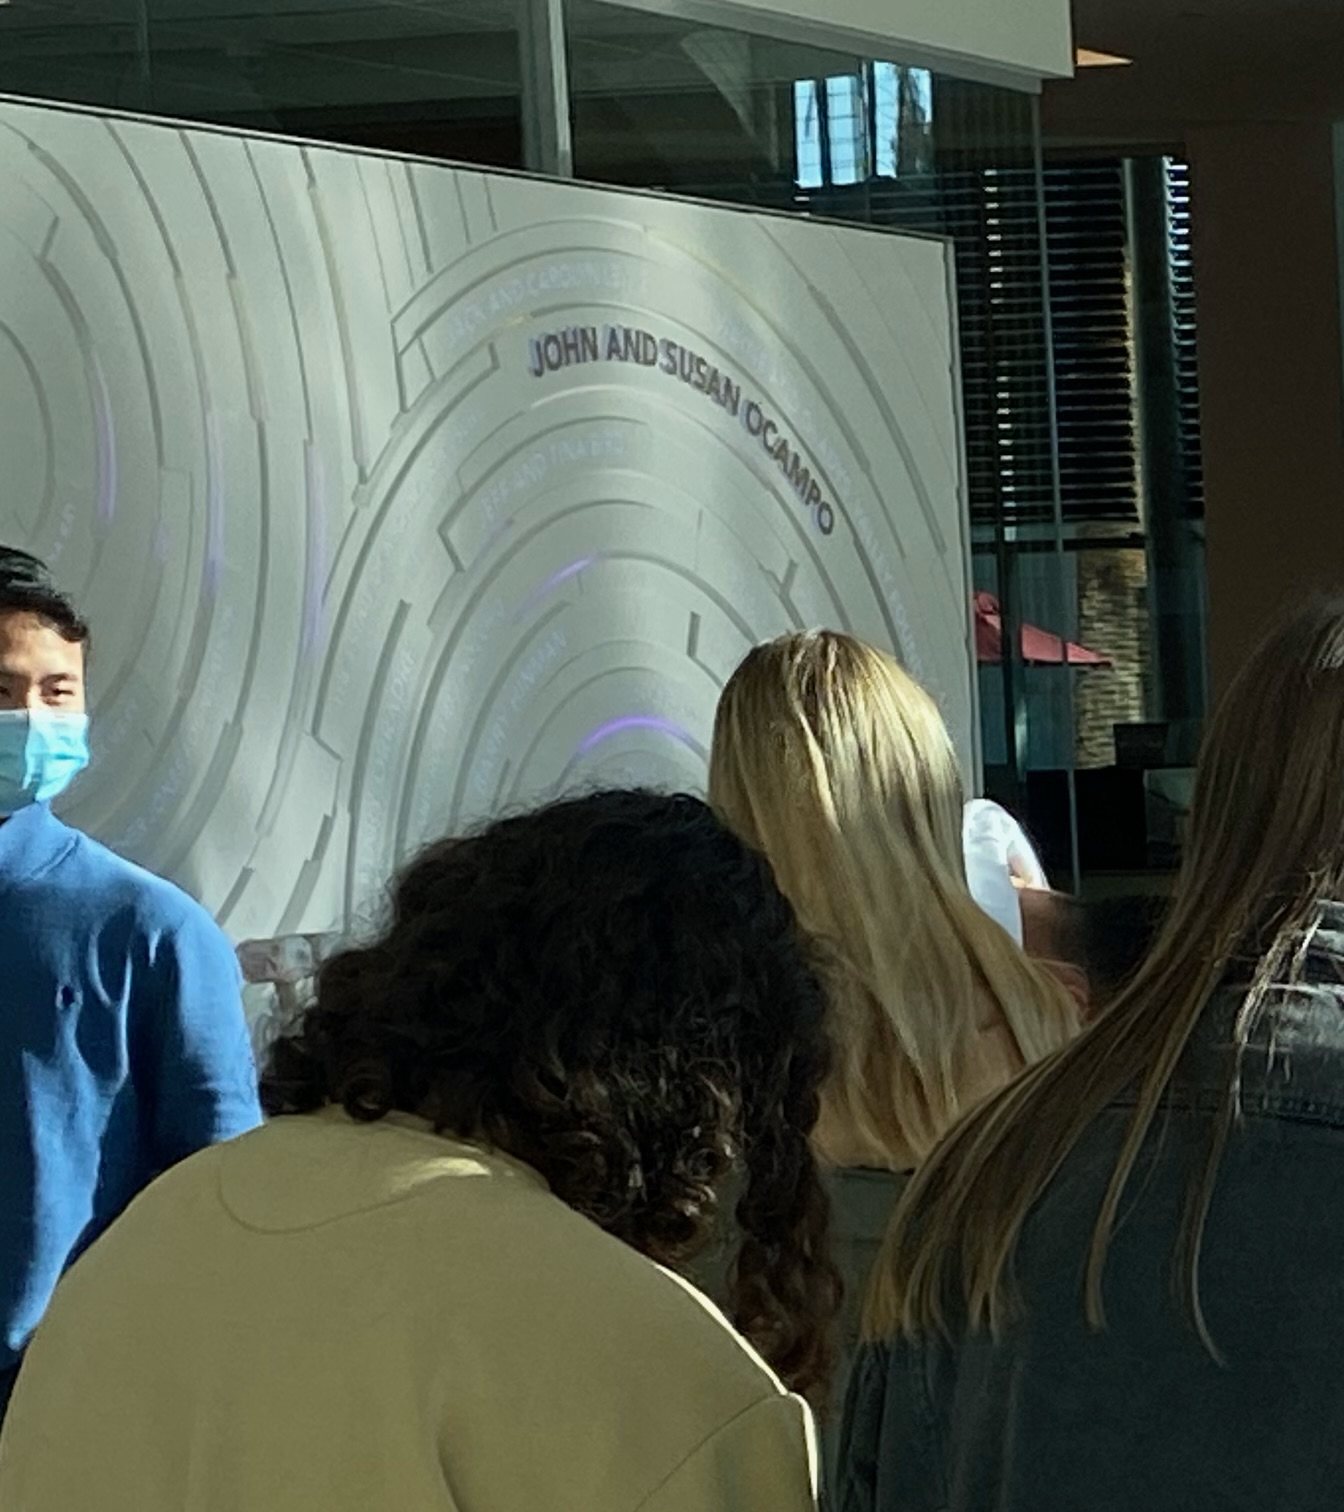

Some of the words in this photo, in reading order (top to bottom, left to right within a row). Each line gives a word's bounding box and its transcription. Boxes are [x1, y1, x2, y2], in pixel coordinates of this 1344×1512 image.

[531, 326, 598, 377] JOHN
[604, 325, 658, 367] AND
[659, 338, 740, 416] SUSAN
[742, 400, 834, 535] OCAMPO
